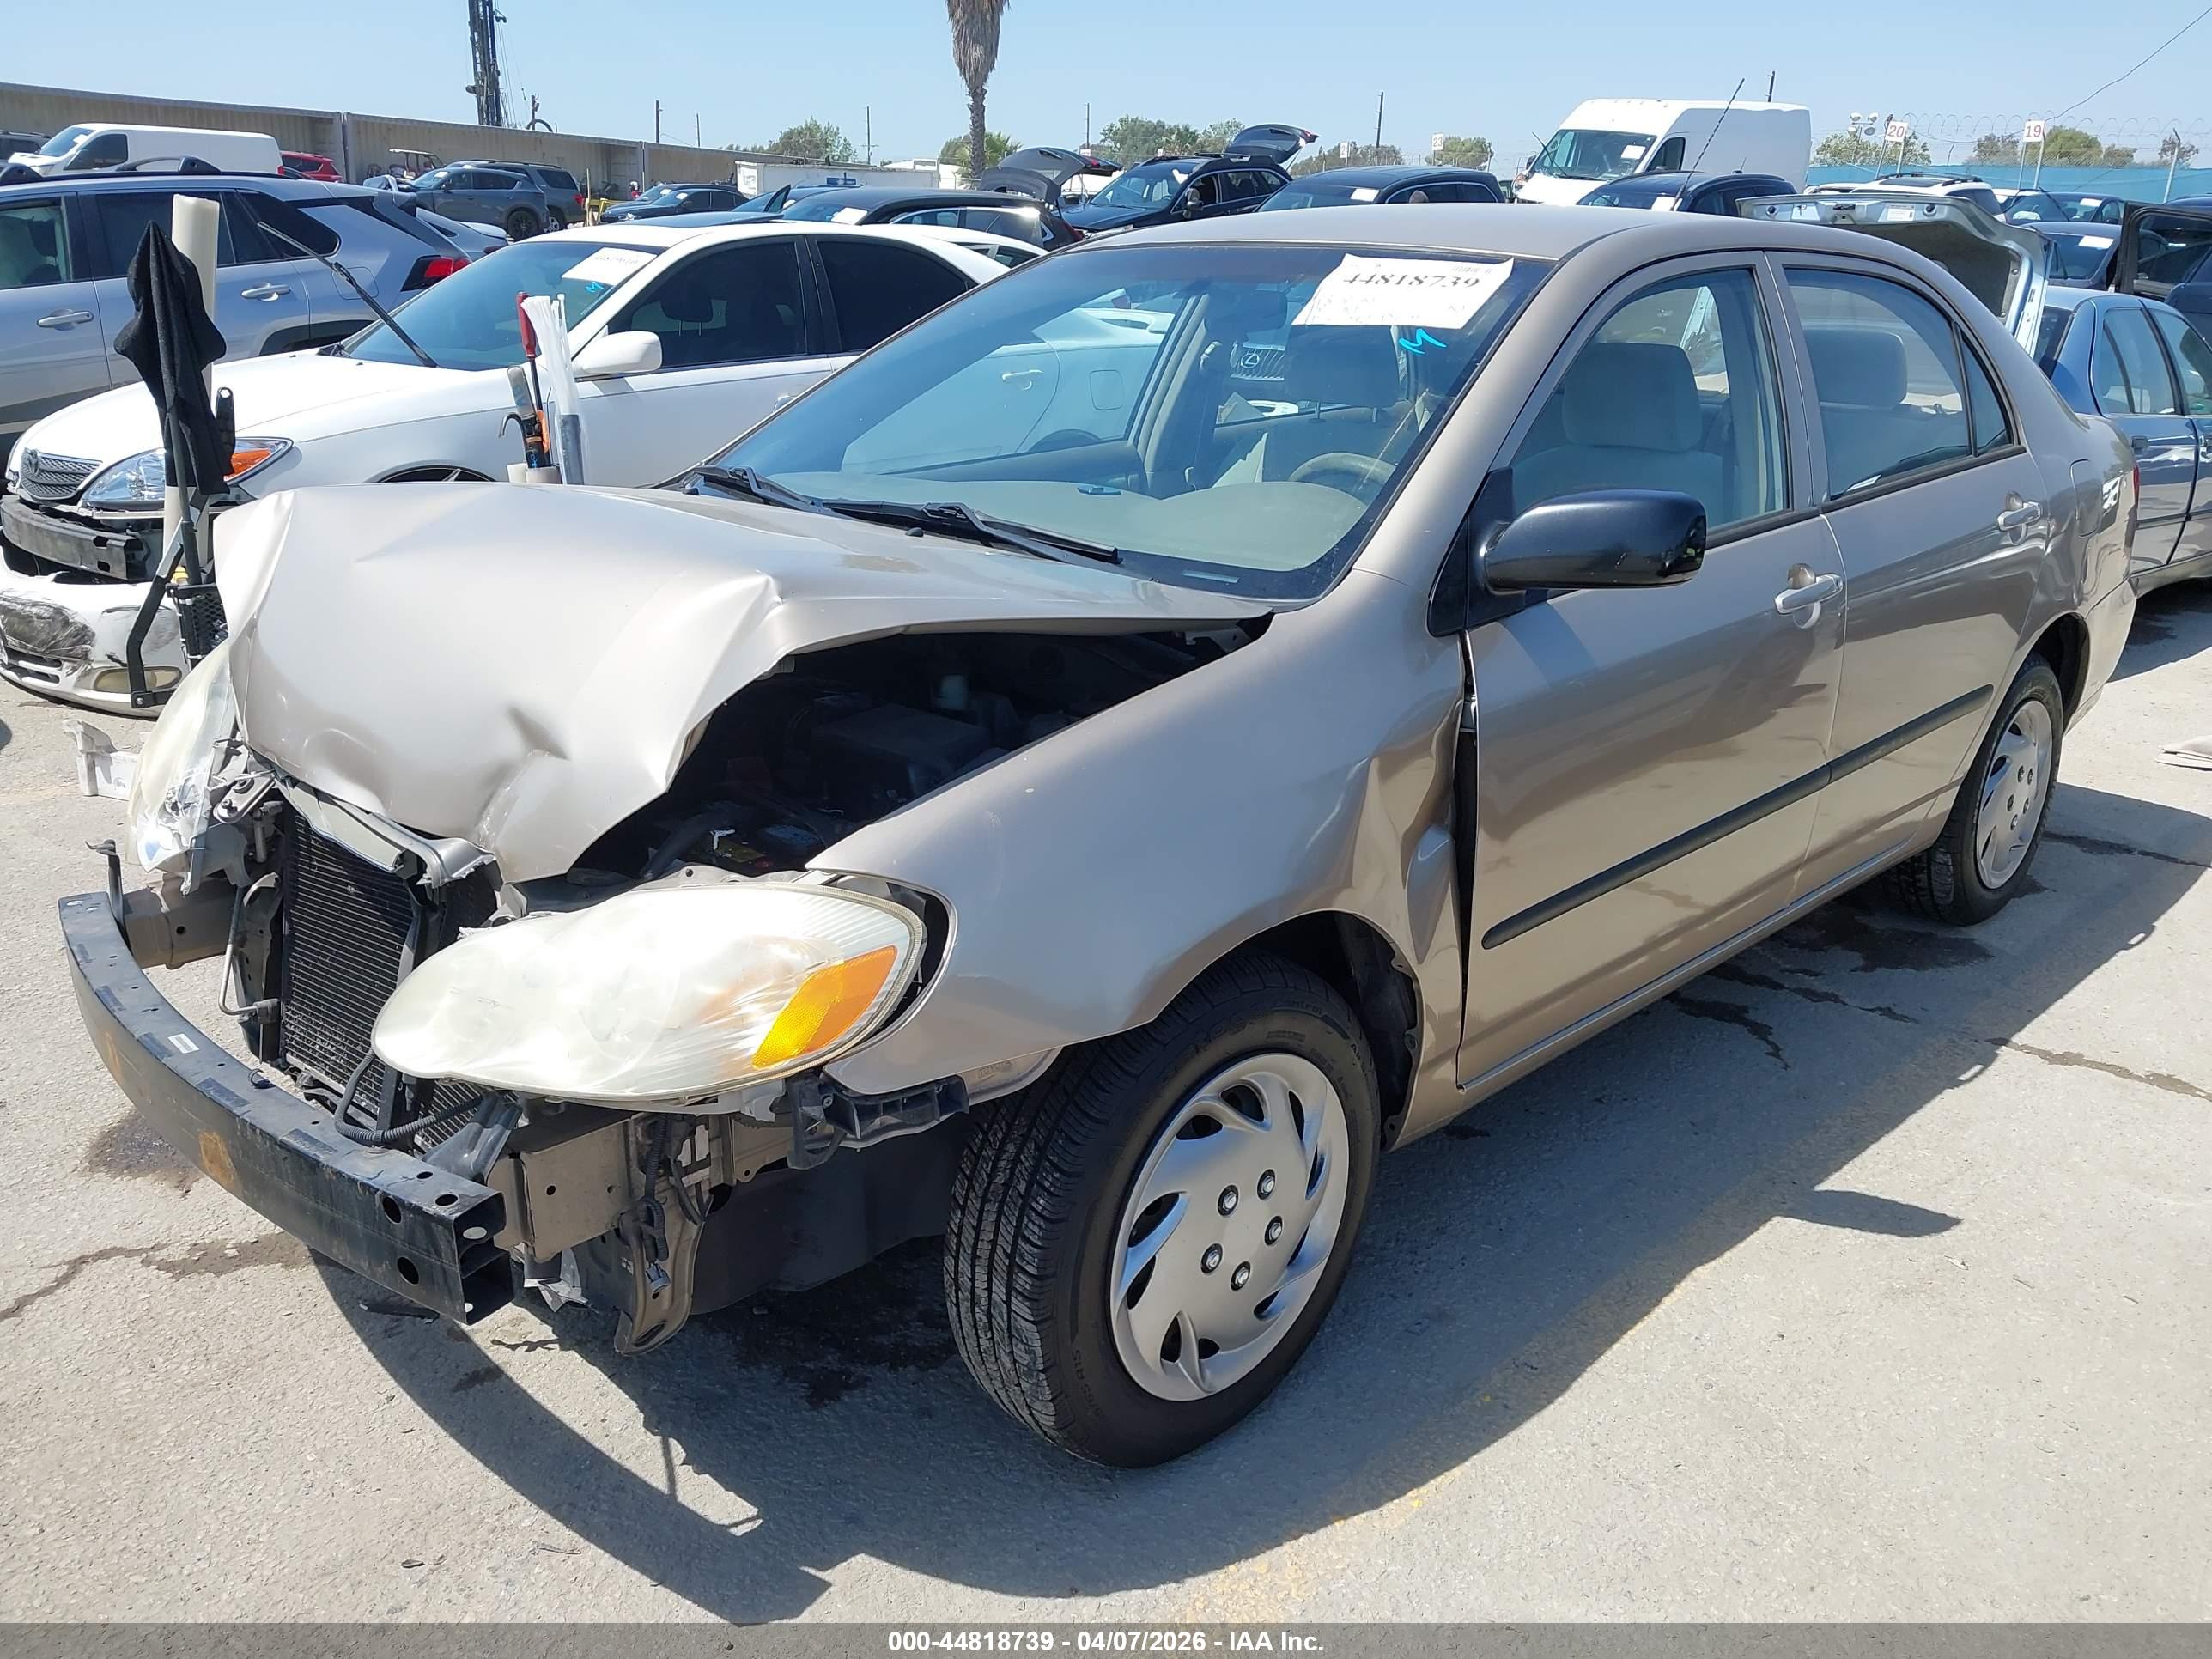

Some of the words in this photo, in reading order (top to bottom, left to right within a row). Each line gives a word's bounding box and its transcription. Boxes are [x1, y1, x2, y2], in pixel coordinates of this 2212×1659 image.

[1887, 125, 1905, 138] 20
[2025, 125, 2042, 138] 19
[1432, 137, 1443, 148] 23
[1343, 272, 1480, 289] 44818739
[1398, 328, 1448, 355] M
